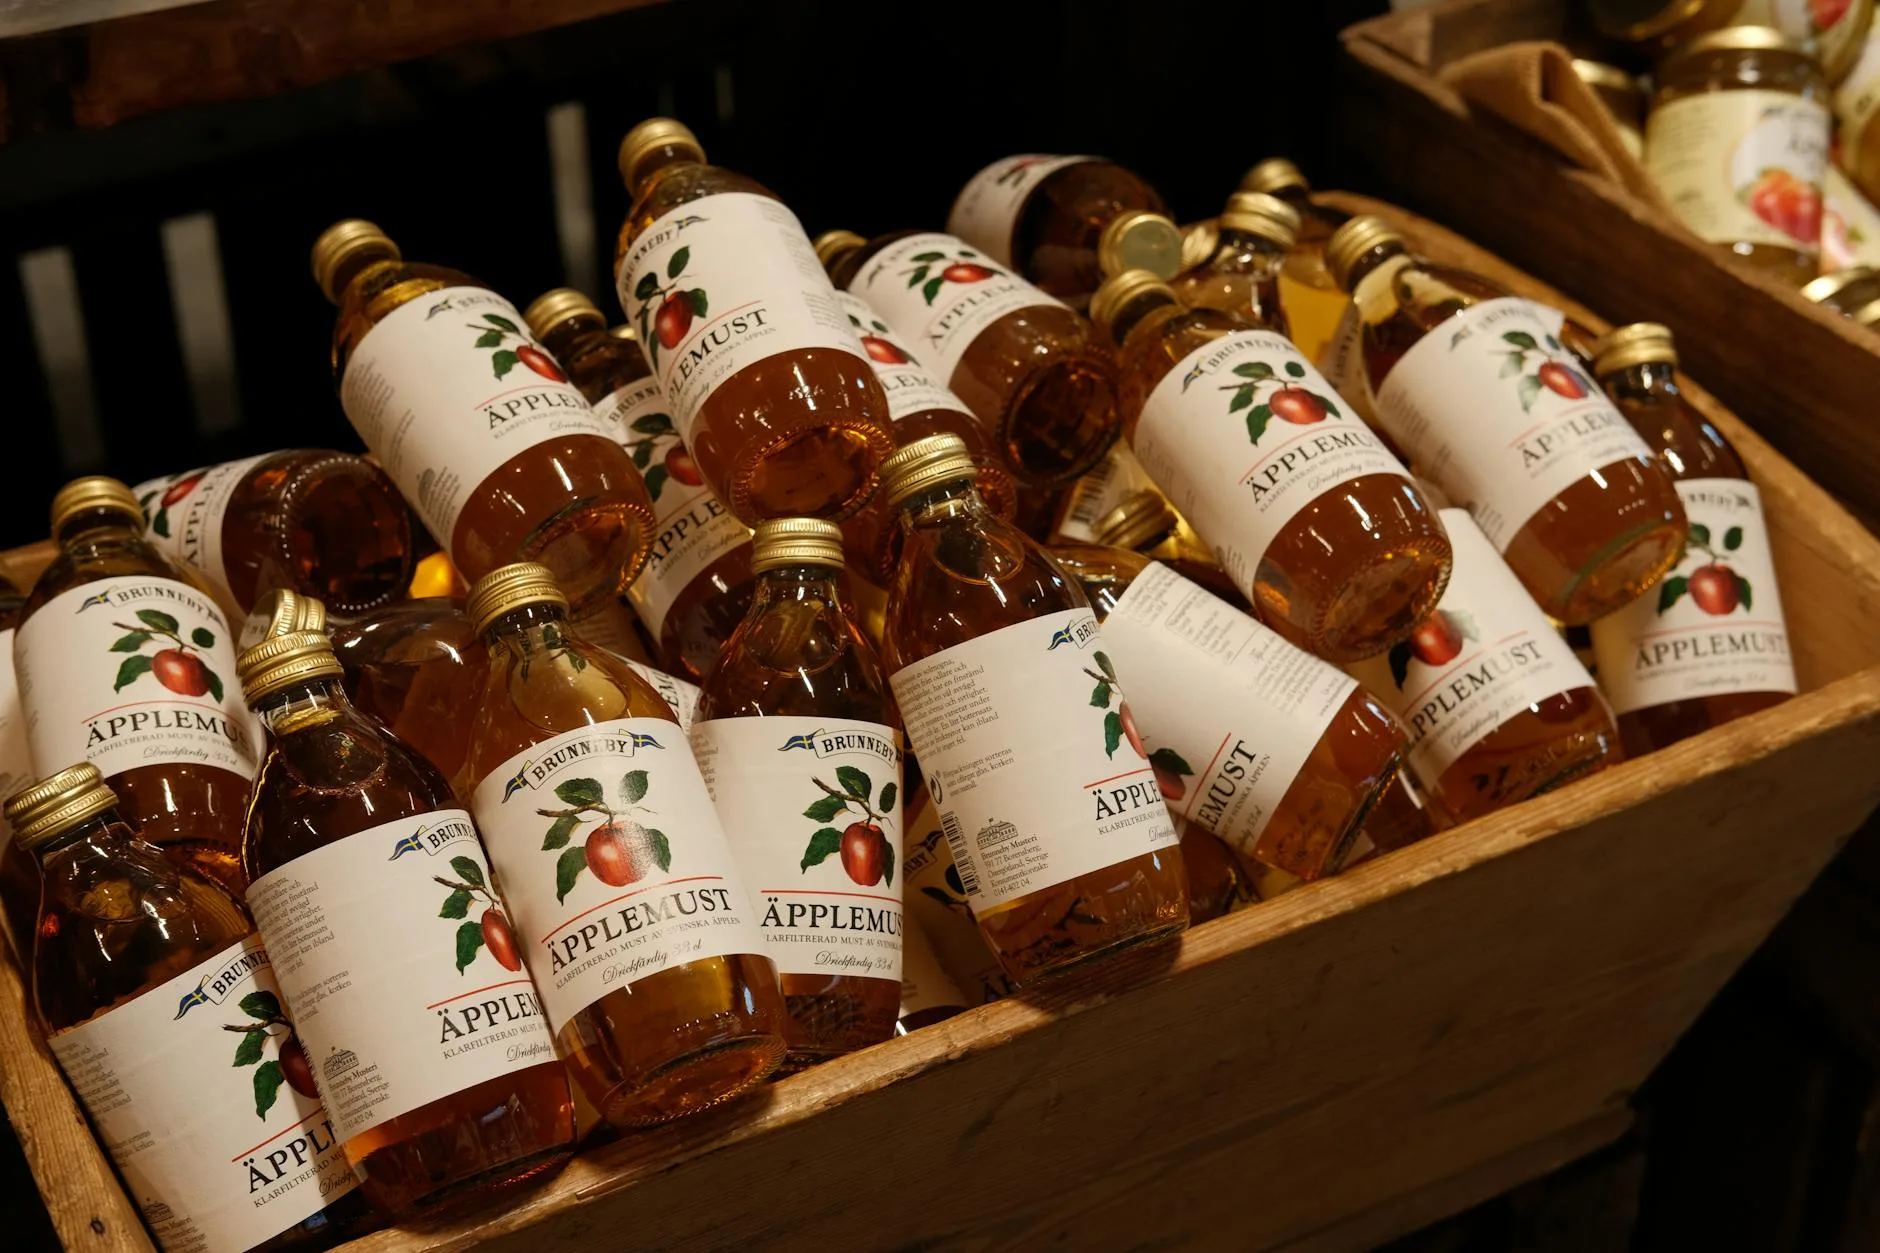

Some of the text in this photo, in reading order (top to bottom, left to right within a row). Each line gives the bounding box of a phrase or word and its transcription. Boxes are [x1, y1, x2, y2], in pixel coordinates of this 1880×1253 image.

[484, 392, 591, 430] ÄPPLEM
[608, 385, 662, 423] BRUNN
[116, 586, 205, 613] BRUNNEBY
[1411, 640, 1543, 743] PPLEMUST
[532, 739, 628, 781] BRUNNBY
[821, 736, 896, 762] BRUNNEBY
[1093, 779, 1161, 821] ÄPPLE
[553, 889, 732, 975] ÄPPLEMUST
[761, 897, 903, 937] ÄPPLEMUS
[556, 947, 618, 990] KLARFILTRERAD
[619, 934, 648, 954] MUST
[712, 915, 741, 927] ÄPPLEN
[766, 934, 838, 944] LARFILTRERAD
[840, 936, 864, 946] MUST
[813, 950, 873, 972] Drickfärdig
[212, 950, 271, 997] BRUNNE
[602, 949, 667, 985] Drickfärdig
[692, 938, 702, 951] cl
[438, 991, 543, 1045] ÄPPLEM
[444, 1027, 518, 1060] KLARFILTRERAD
[243, 1119, 338, 1195] ÄPPL
[253, 1156, 330, 1208] KLARFILTRERAD
